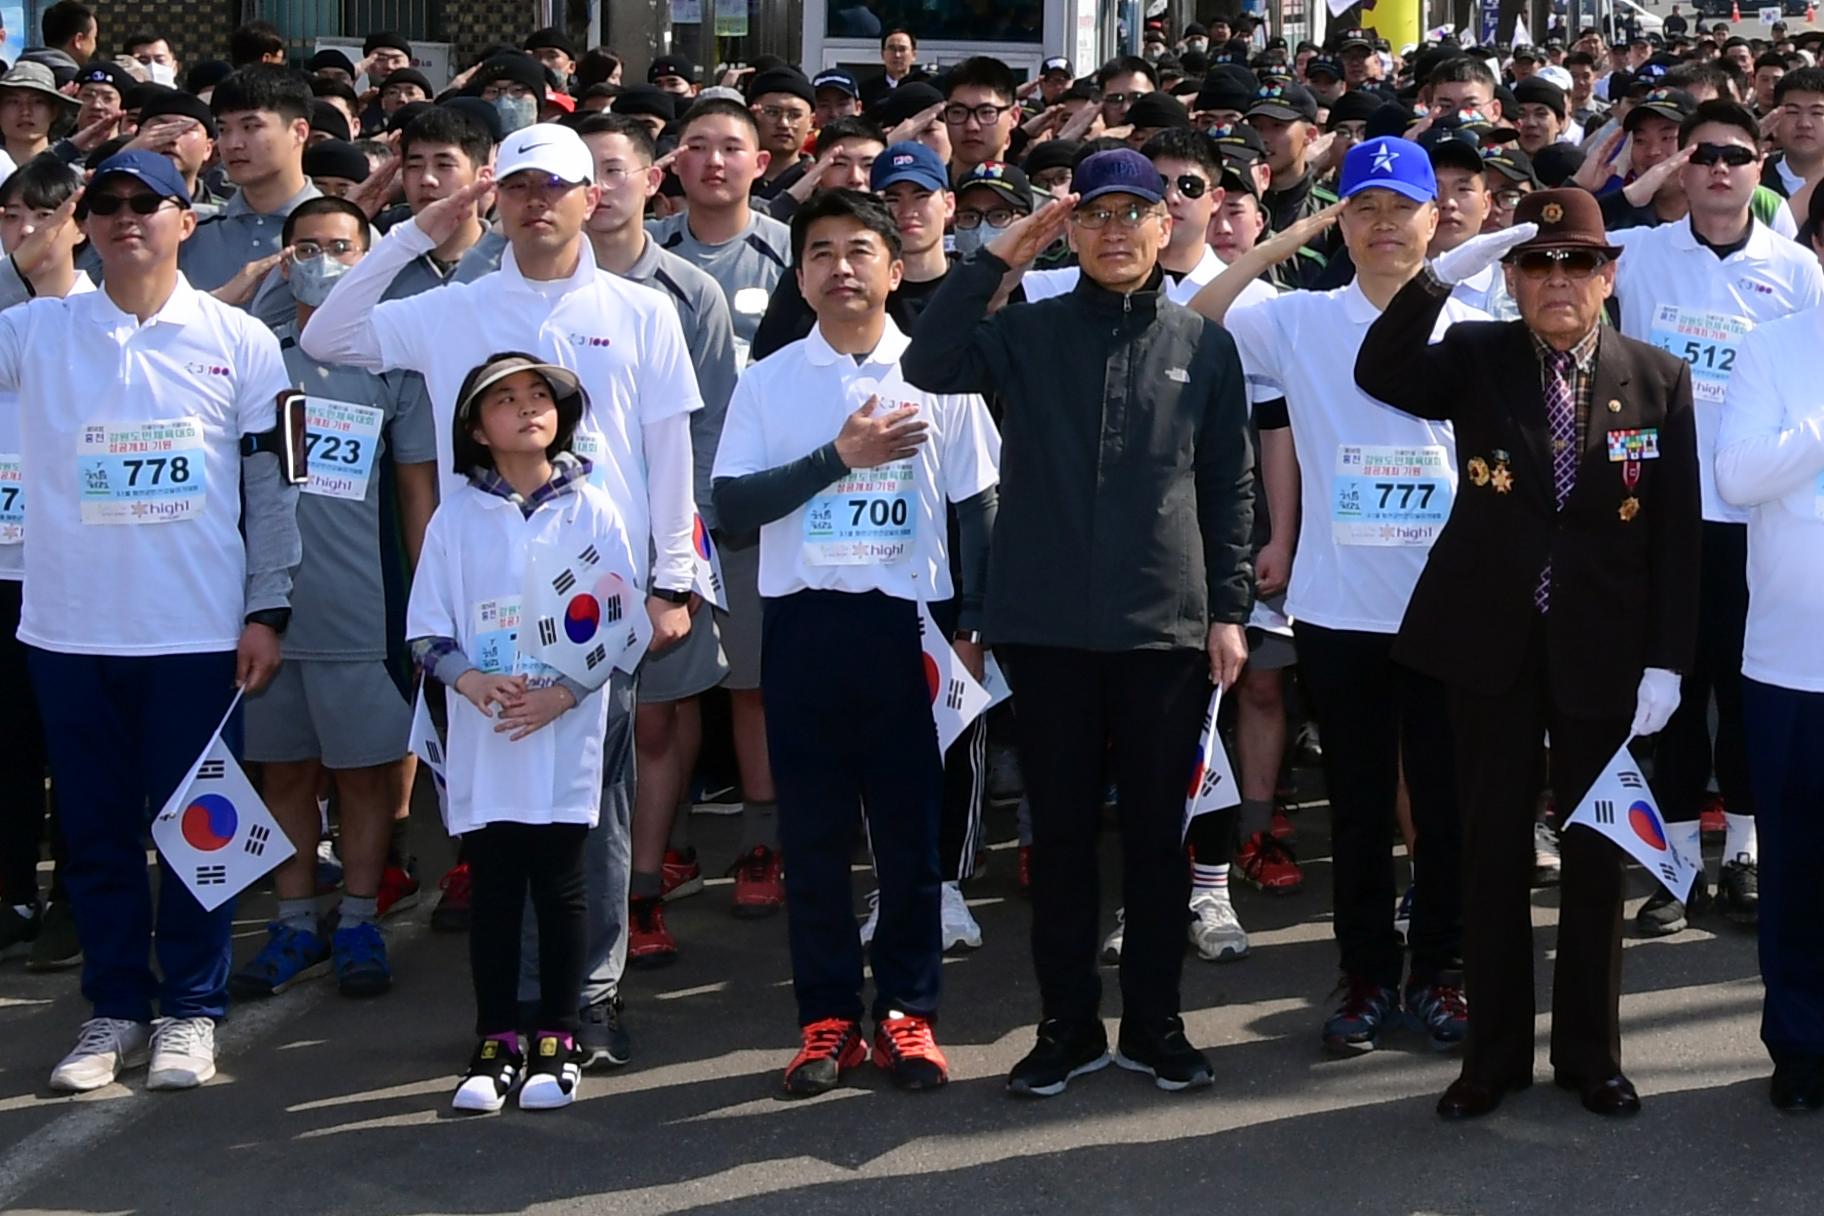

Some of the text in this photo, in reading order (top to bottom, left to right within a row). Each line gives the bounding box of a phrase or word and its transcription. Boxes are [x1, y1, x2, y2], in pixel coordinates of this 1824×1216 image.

[1682, 341, 1737, 371] 512
[306, 432, 361, 465] 723
[123, 456, 190, 487] 778
[1375, 483, 1436, 510] 777
[848, 498, 907, 527] 700
